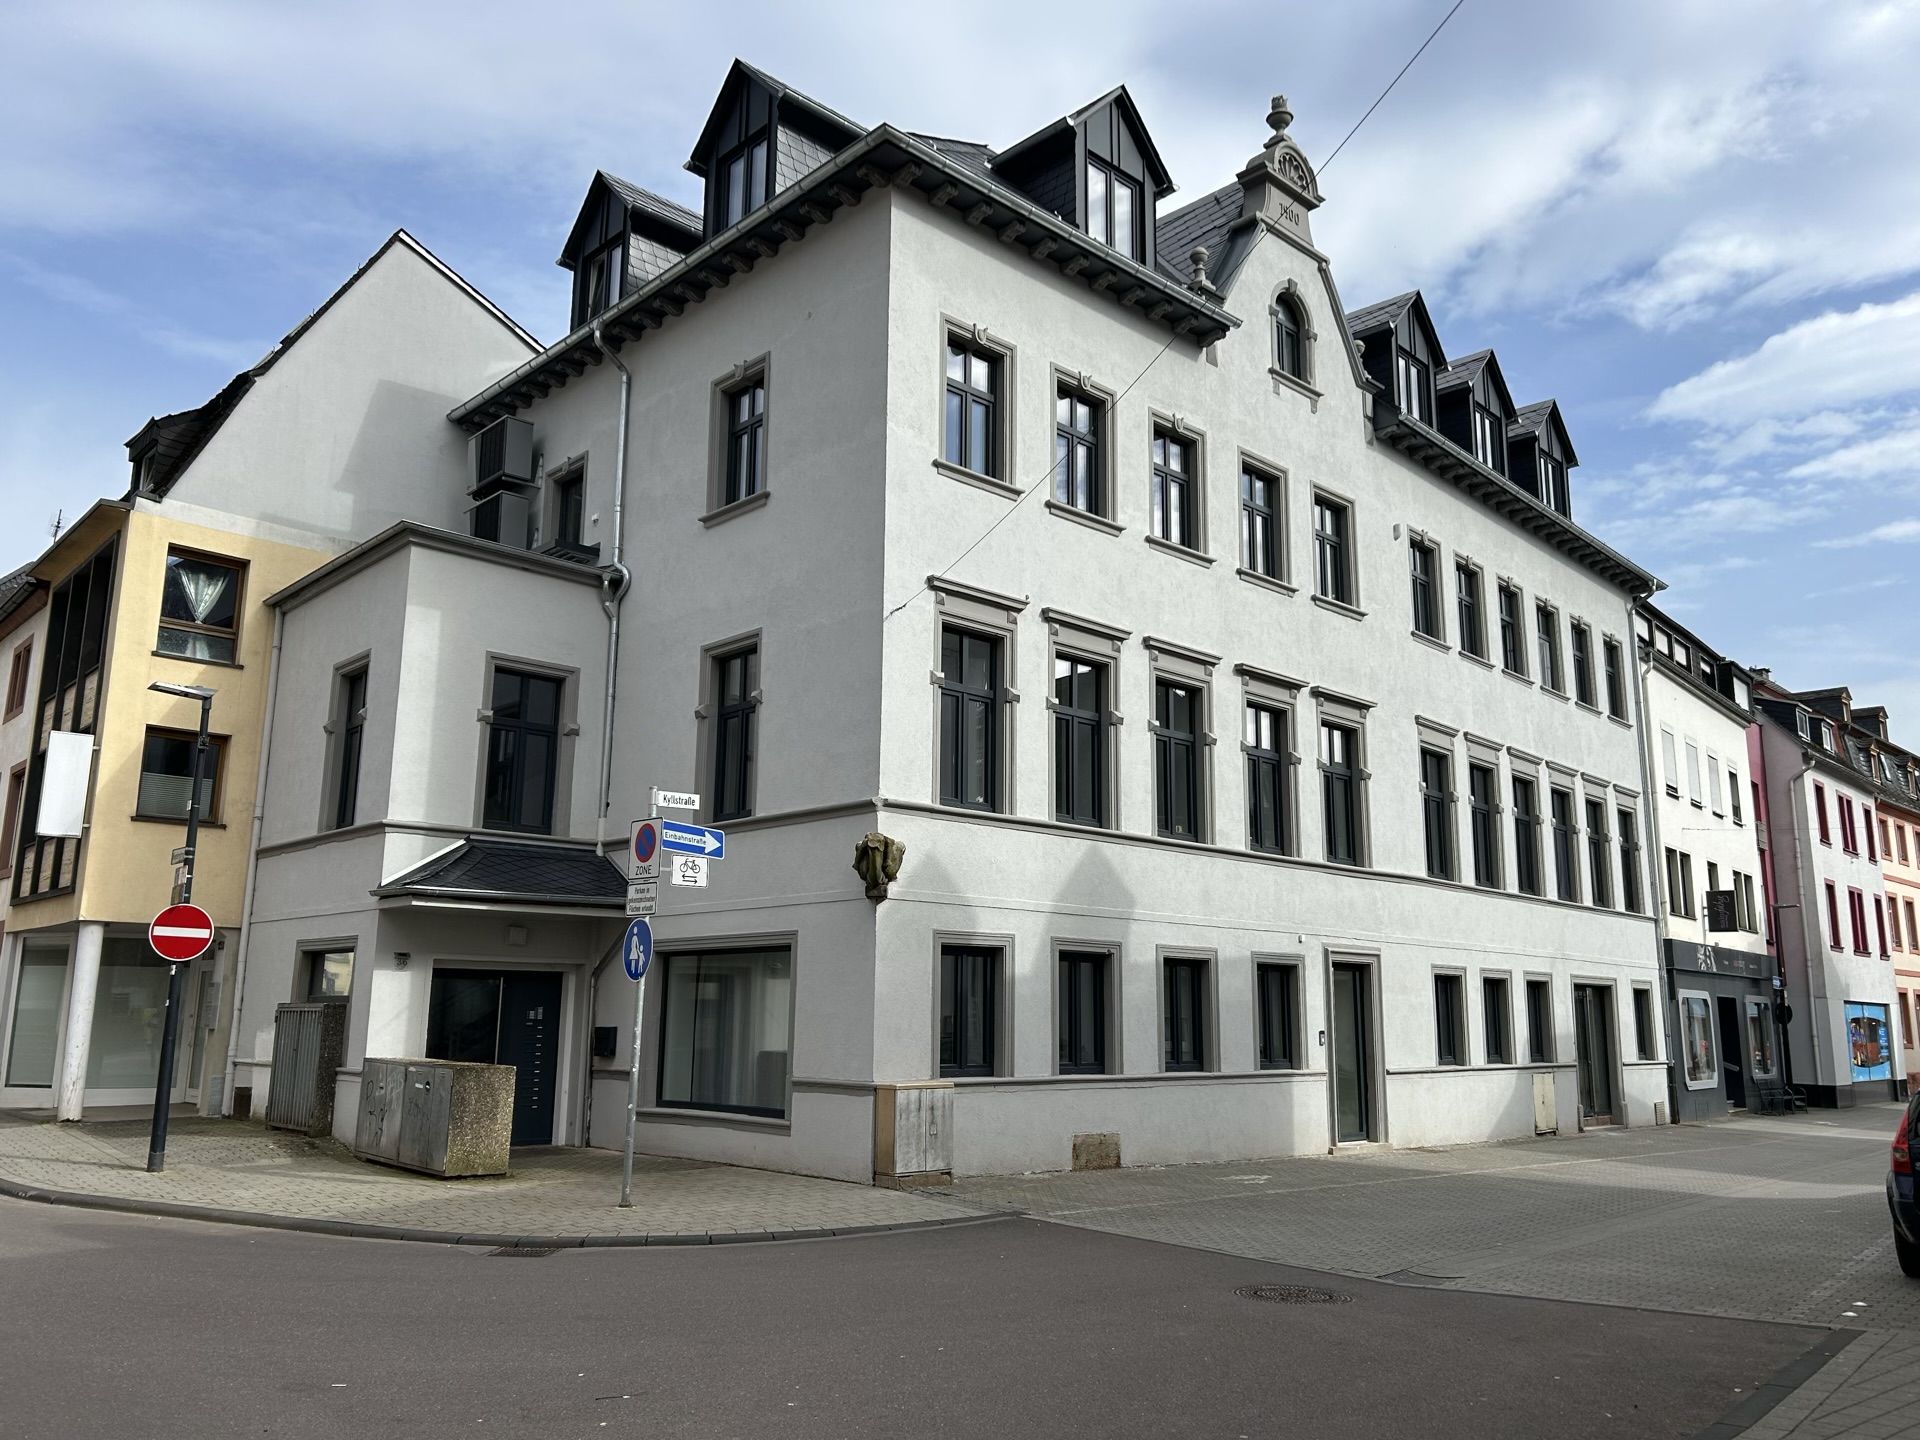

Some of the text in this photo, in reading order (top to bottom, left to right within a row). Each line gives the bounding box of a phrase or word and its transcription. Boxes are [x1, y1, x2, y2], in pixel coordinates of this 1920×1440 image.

[1279, 203, 1299, 226] 1900
[663, 794, 696, 807] Kyllstraße
[664, 831, 707, 845] Einbahnstraße
[635, 865, 652, 876] ZONE
